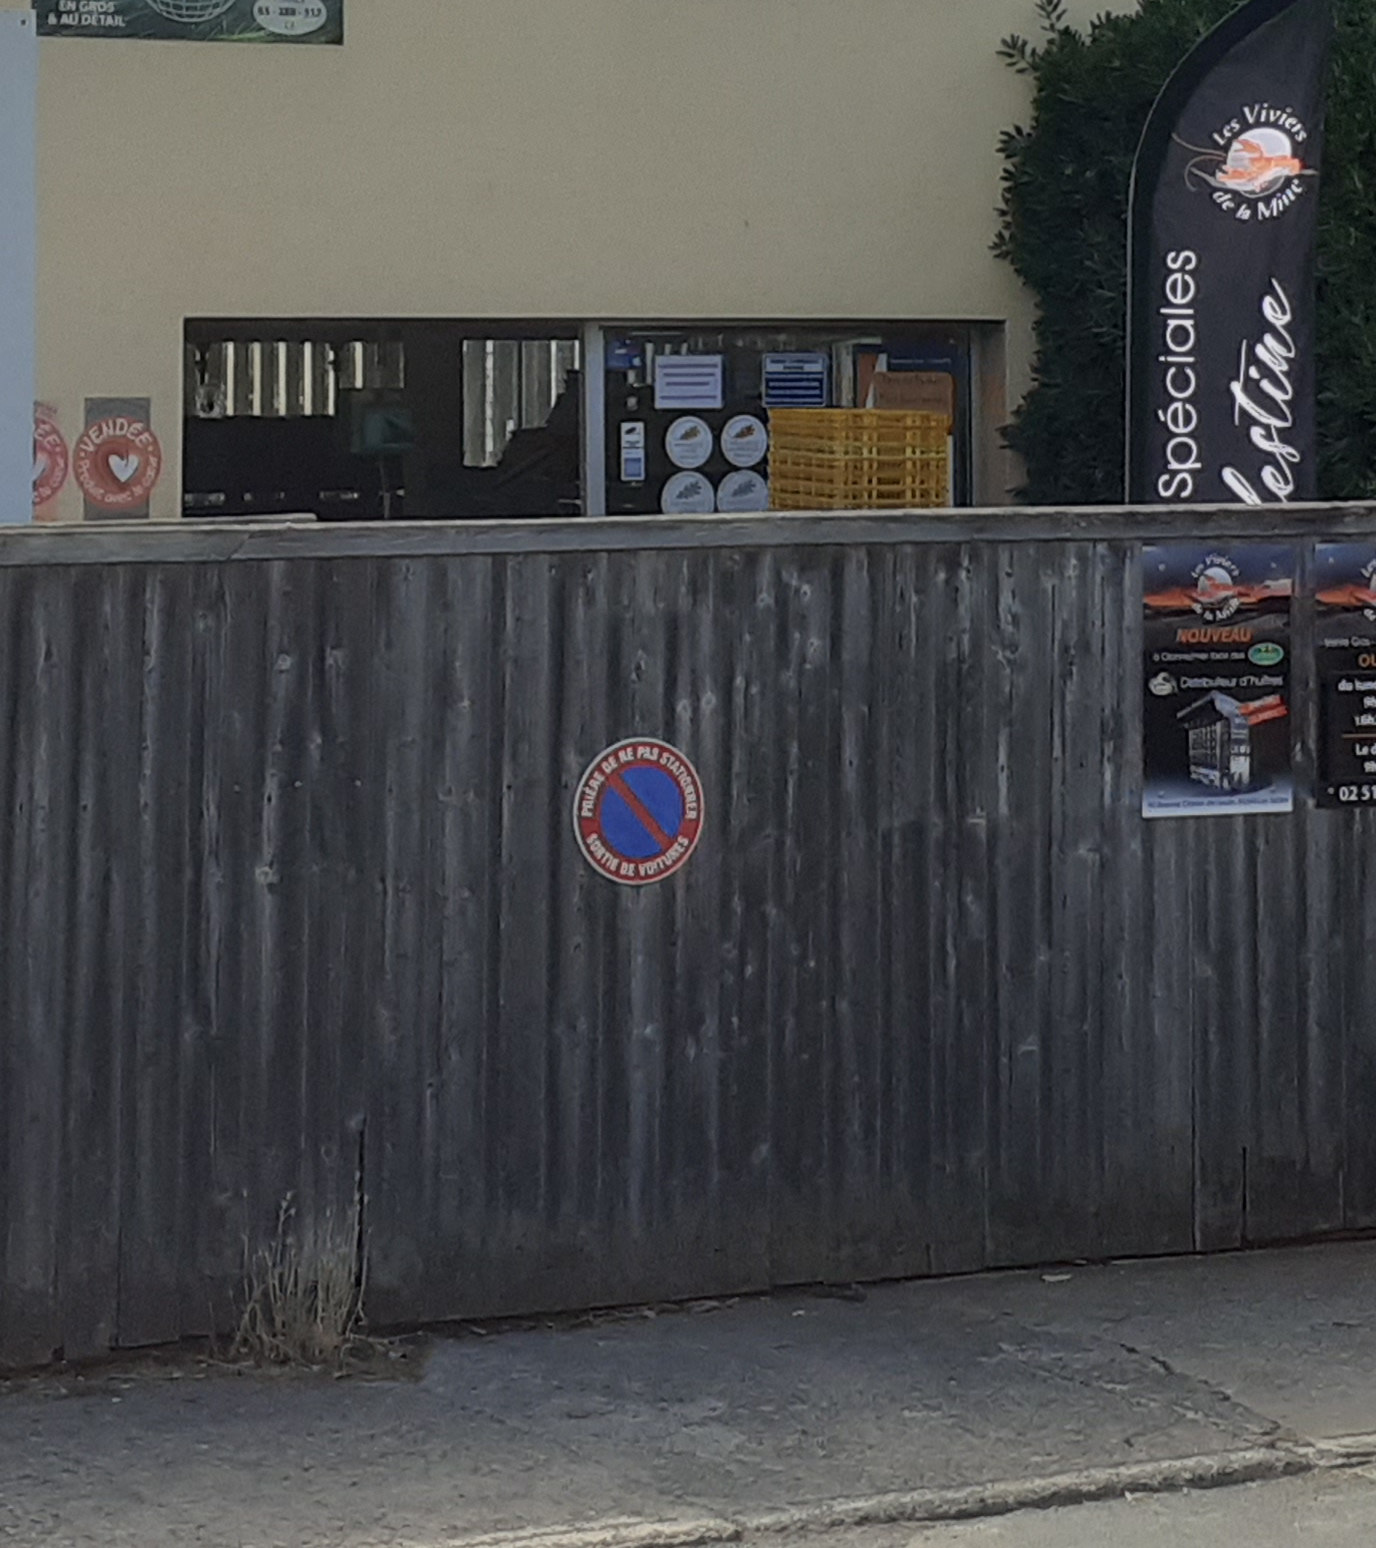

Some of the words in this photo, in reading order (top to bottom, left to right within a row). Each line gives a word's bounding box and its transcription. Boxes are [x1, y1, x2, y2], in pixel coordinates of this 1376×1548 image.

[58, 0, 76, 12] EN
[78, 1, 115, 13] GROS
[60, 13, 79, 25] AU
[1212, 119, 1240, 146] Les
[1242, 102, 1307, 142] Viviers
[1212, 191, 1235, 210] de
[1235, 204, 1251, 220] la
[1257, 179, 1303, 221] Mine
[1176, 628, 1254, 643] NOUVEAU
[1355, 743, 1369, 755] Le
[581, 771, 605, 817] PRIÈRE
[601, 755, 618, 773] DE
[618, 747, 635, 763] NE
[636, 746, 659, 761] PAS
[659, 752, 698, 820] STATIONNER
[1339, 786, 1358, 801] 02
[586, 833, 617, 871] SORTIE
[620, 862, 636, 876] DE
[638, 835, 689, 877] VOITURES
